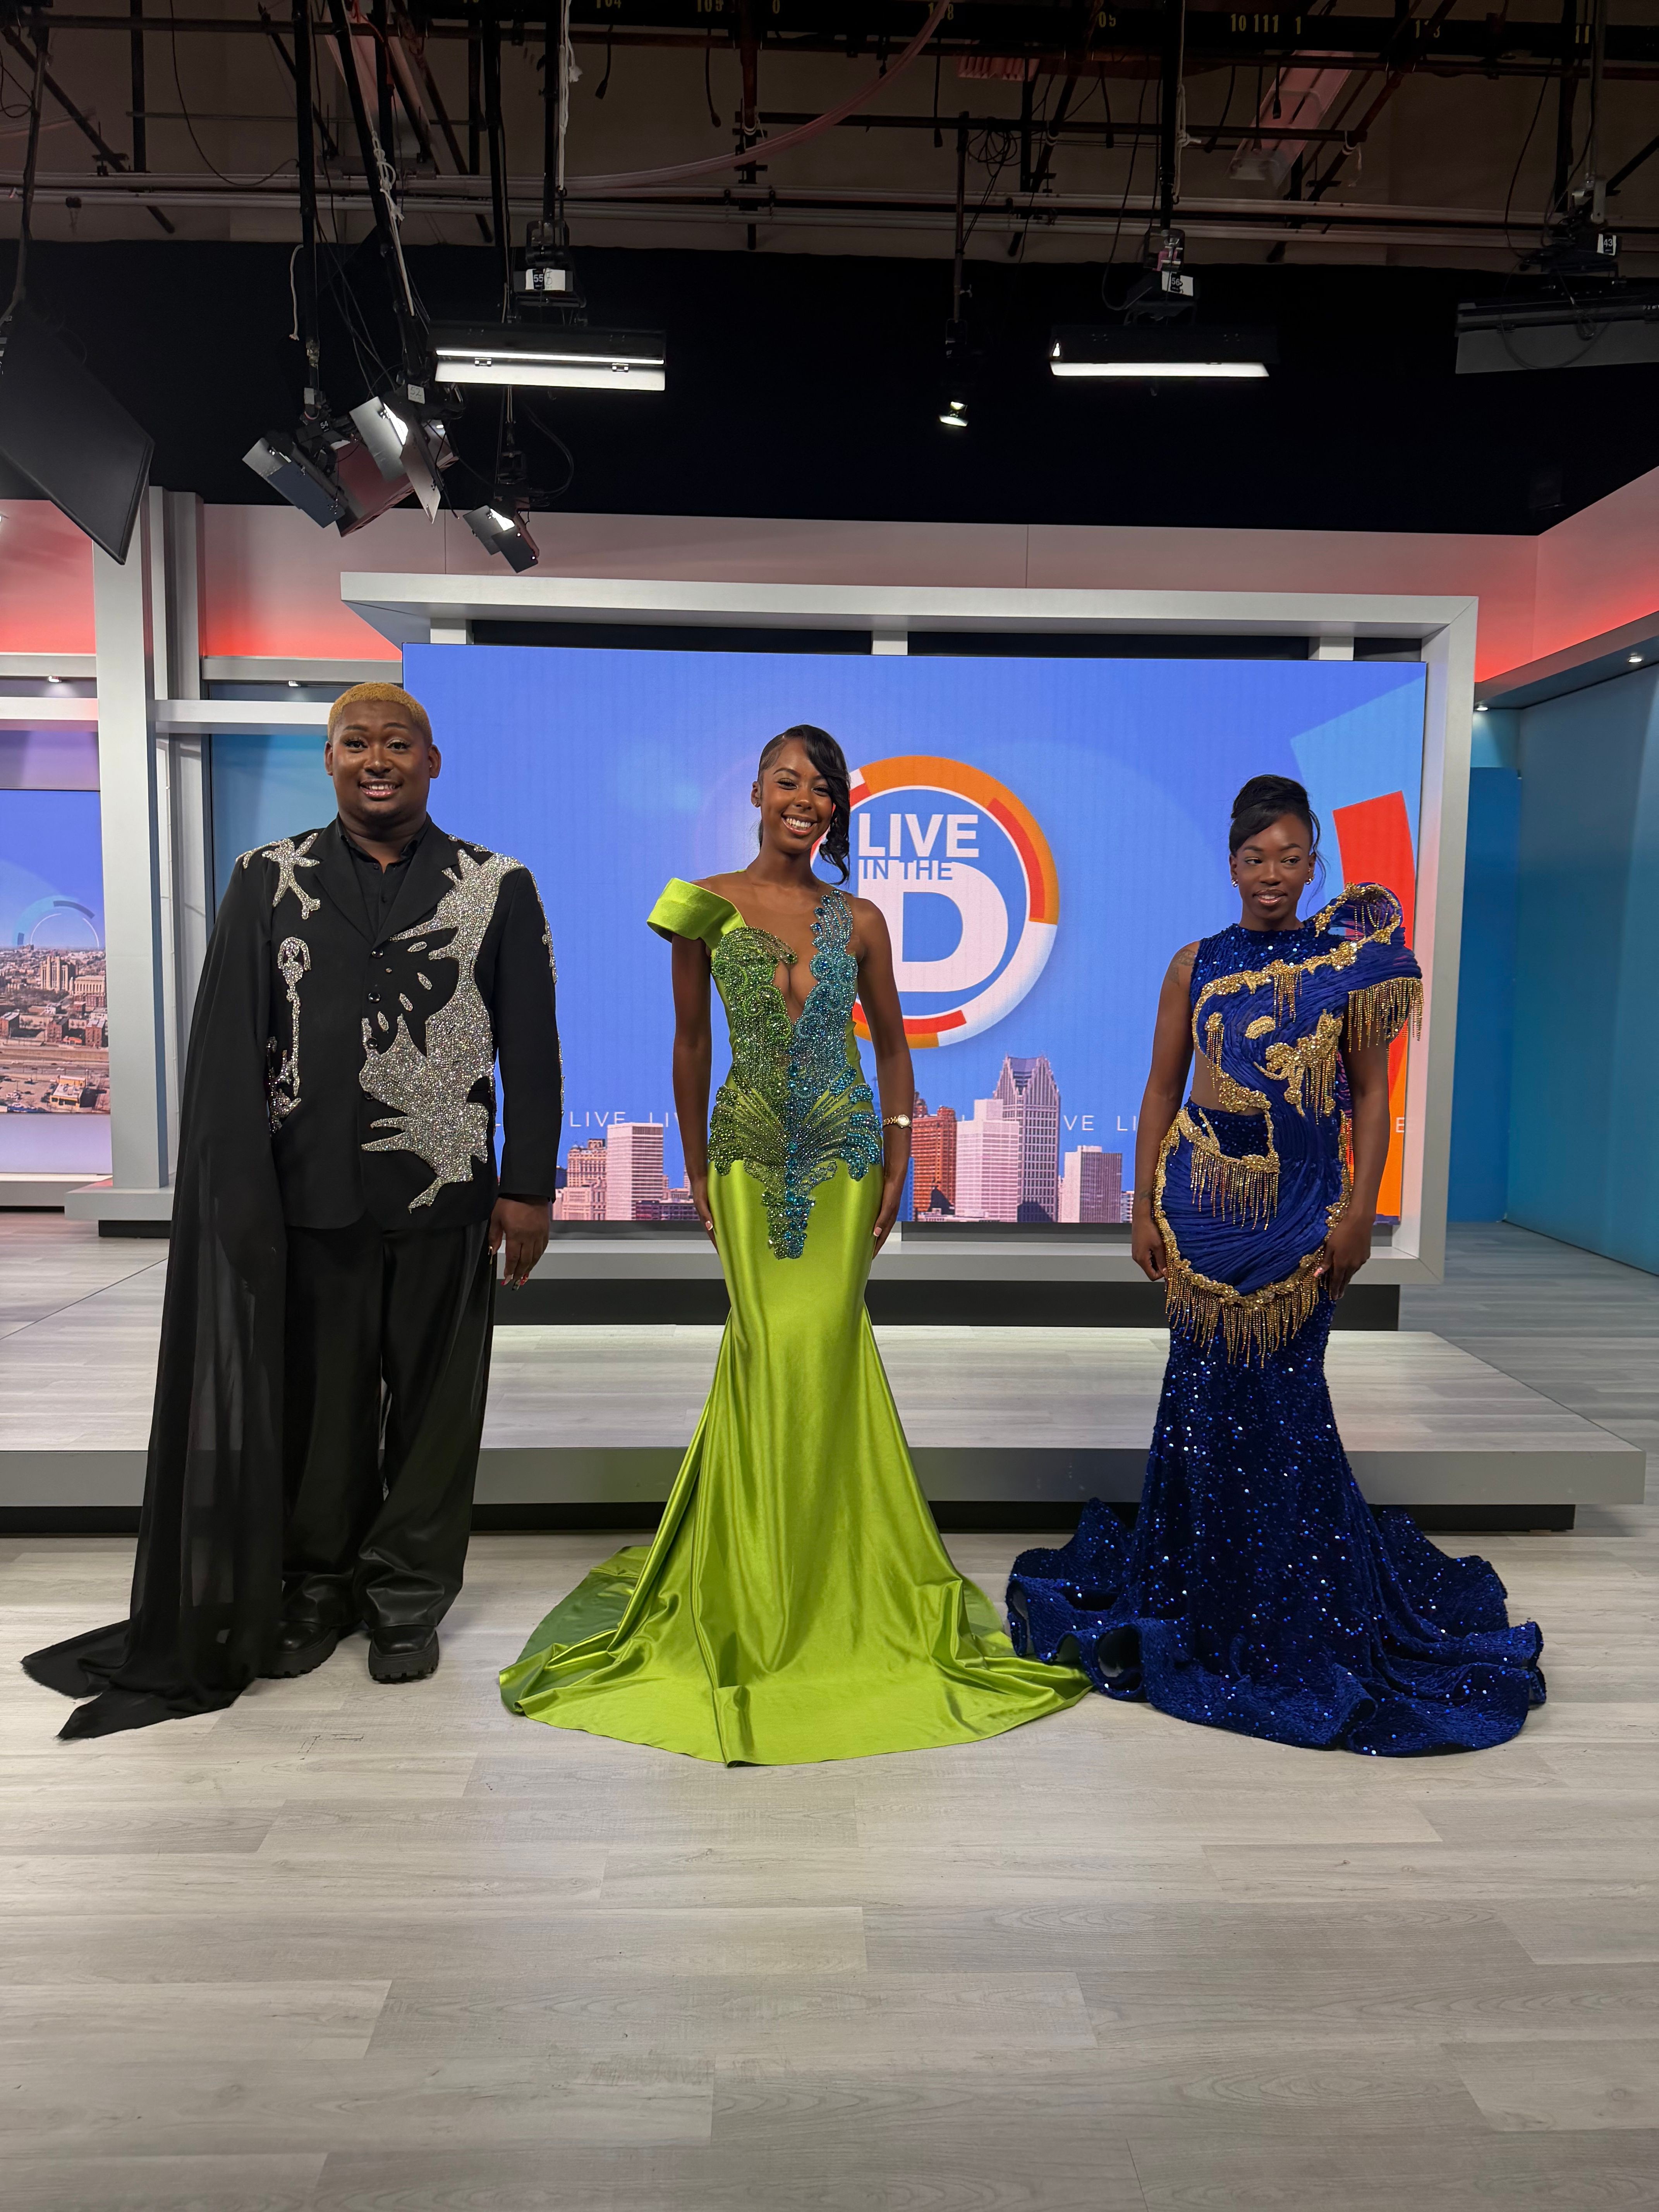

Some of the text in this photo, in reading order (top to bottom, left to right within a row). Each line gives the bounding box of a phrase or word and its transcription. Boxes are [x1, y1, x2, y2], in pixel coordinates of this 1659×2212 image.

[928, 3, 954, 21] 18
[1604, 238, 1613, 248] 43
[533, 274, 544, 283] 55
[1171, 277, 1180, 287] 56
[410, 386, 422, 397] 52
[320, 421, 328, 429] 54
[859, 813, 979, 857] LIVE
[863, 859, 953, 880] IN THE
[859, 859, 1008, 992] D
[570, 1111, 626, 1127] LIVE
[1063, 1115, 1094, 1130] VE
